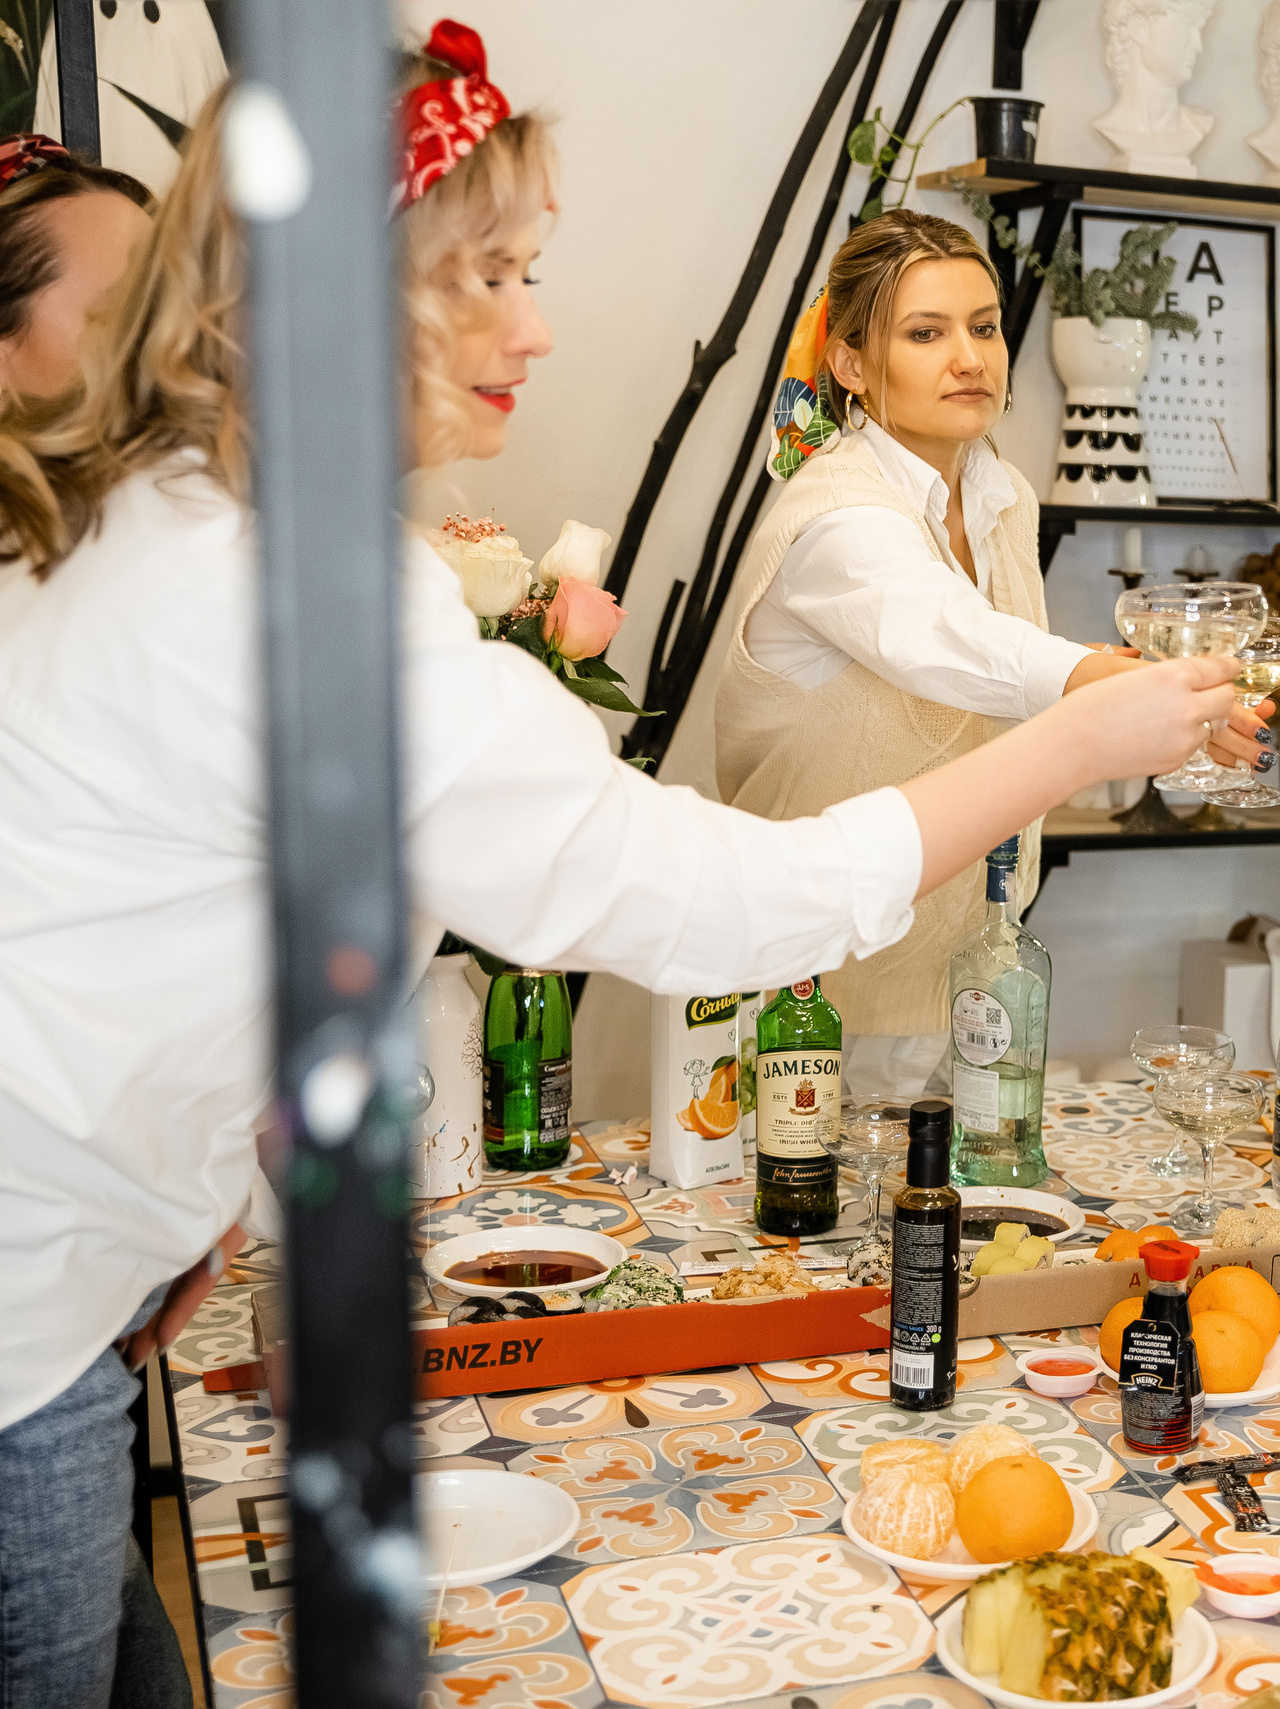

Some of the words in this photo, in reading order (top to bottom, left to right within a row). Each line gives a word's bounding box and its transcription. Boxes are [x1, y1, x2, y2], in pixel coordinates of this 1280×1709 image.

[763, 1058, 841, 1080] JAMESON
[705, 1163, 731, 1174] АПЕЛЬСИН
[925, 1324, 937, 1333] 300
[1133, 1340, 1168, 1349] ТЕХНОЛОГИЯ
[1128, 1347, 1171, 1357] ПРОИЗВОДСТВА
[1134, 1355, 1176, 1365] КОНСЕРВАНТОВ
[1135, 1376, 1159, 1387] HEINZ
